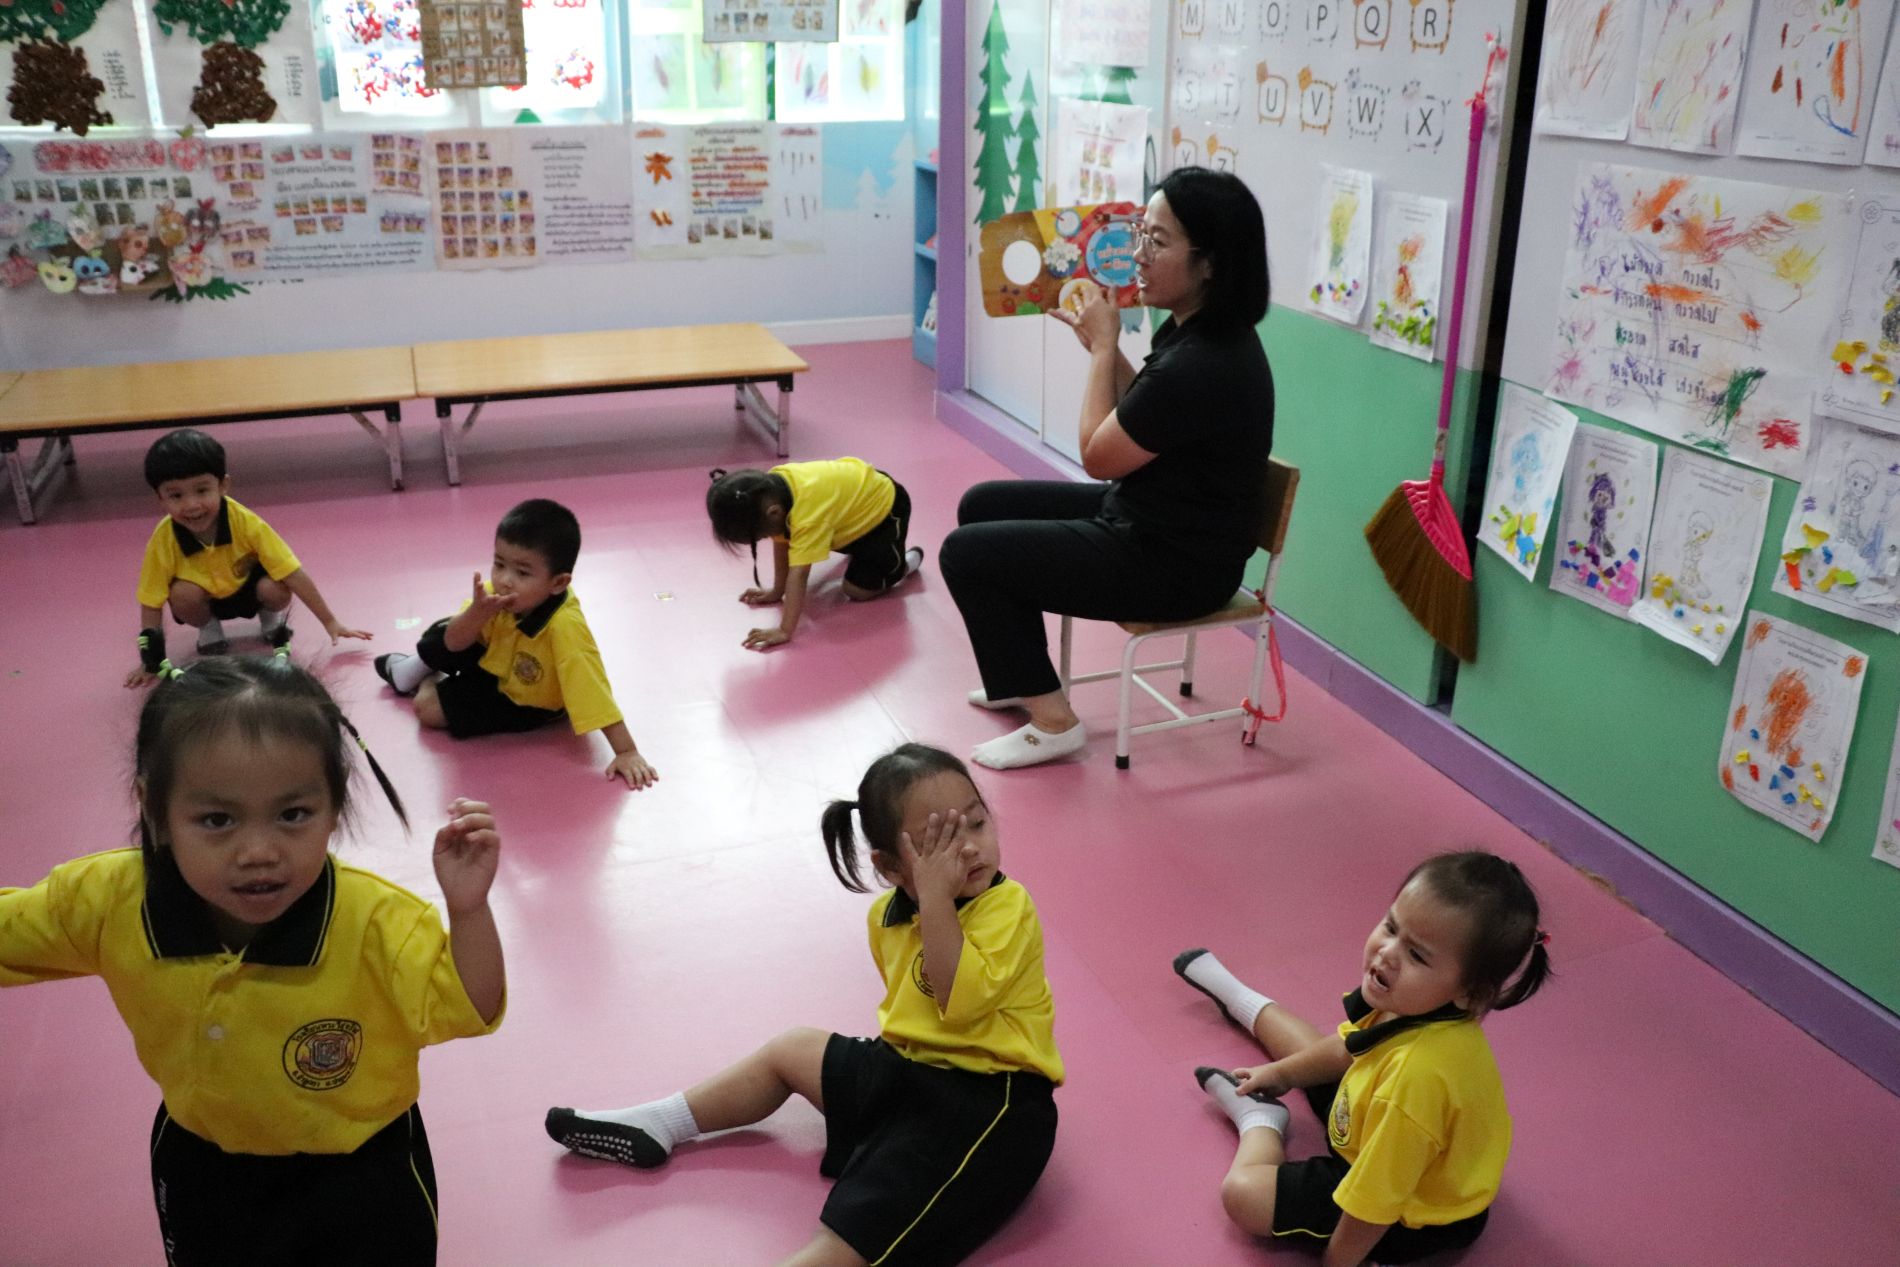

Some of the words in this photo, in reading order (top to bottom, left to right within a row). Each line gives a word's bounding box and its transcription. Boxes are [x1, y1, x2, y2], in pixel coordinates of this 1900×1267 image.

[1186, 4, 1198, 25] M
[1226, 3, 1236, 26] N
[1267, 2, 1280, 27] O
[1317, 5, 1328, 30] P
[1365, 6, 1380, 36] Q
[1424, 8, 1437, 36] R
[1184, 80, 1193, 103] S
[1223, 83, 1234, 106] T
[1266, 88, 1278, 112] U
[1312, 91, 1324, 116] V
[1358, 96, 1377, 124] W
[1417, 107, 1434, 136] X
